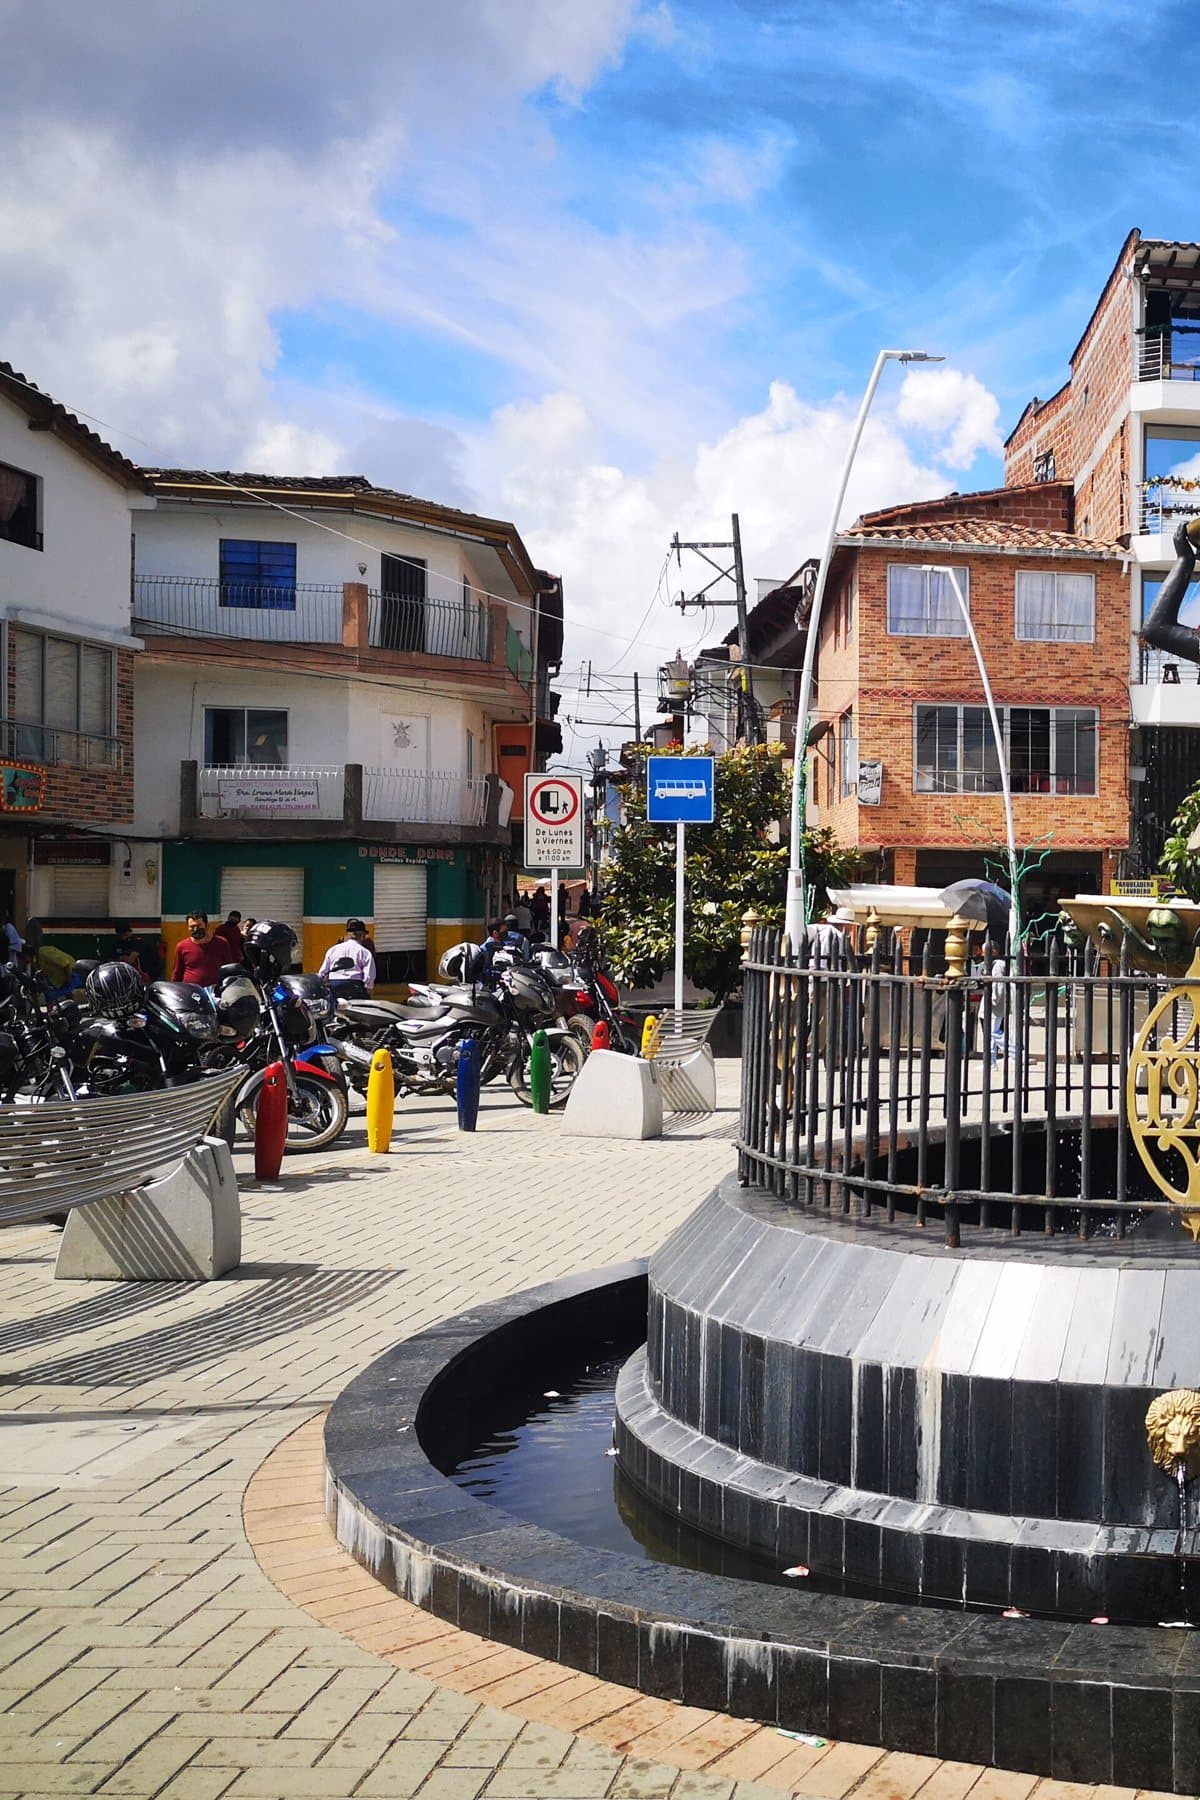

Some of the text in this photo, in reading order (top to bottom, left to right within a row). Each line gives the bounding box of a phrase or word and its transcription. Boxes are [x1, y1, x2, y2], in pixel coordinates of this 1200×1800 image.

[535, 828, 573, 836] De Lunes
[542, 837, 573, 845] Viernes
[358, 847, 407, 858] DONDE
